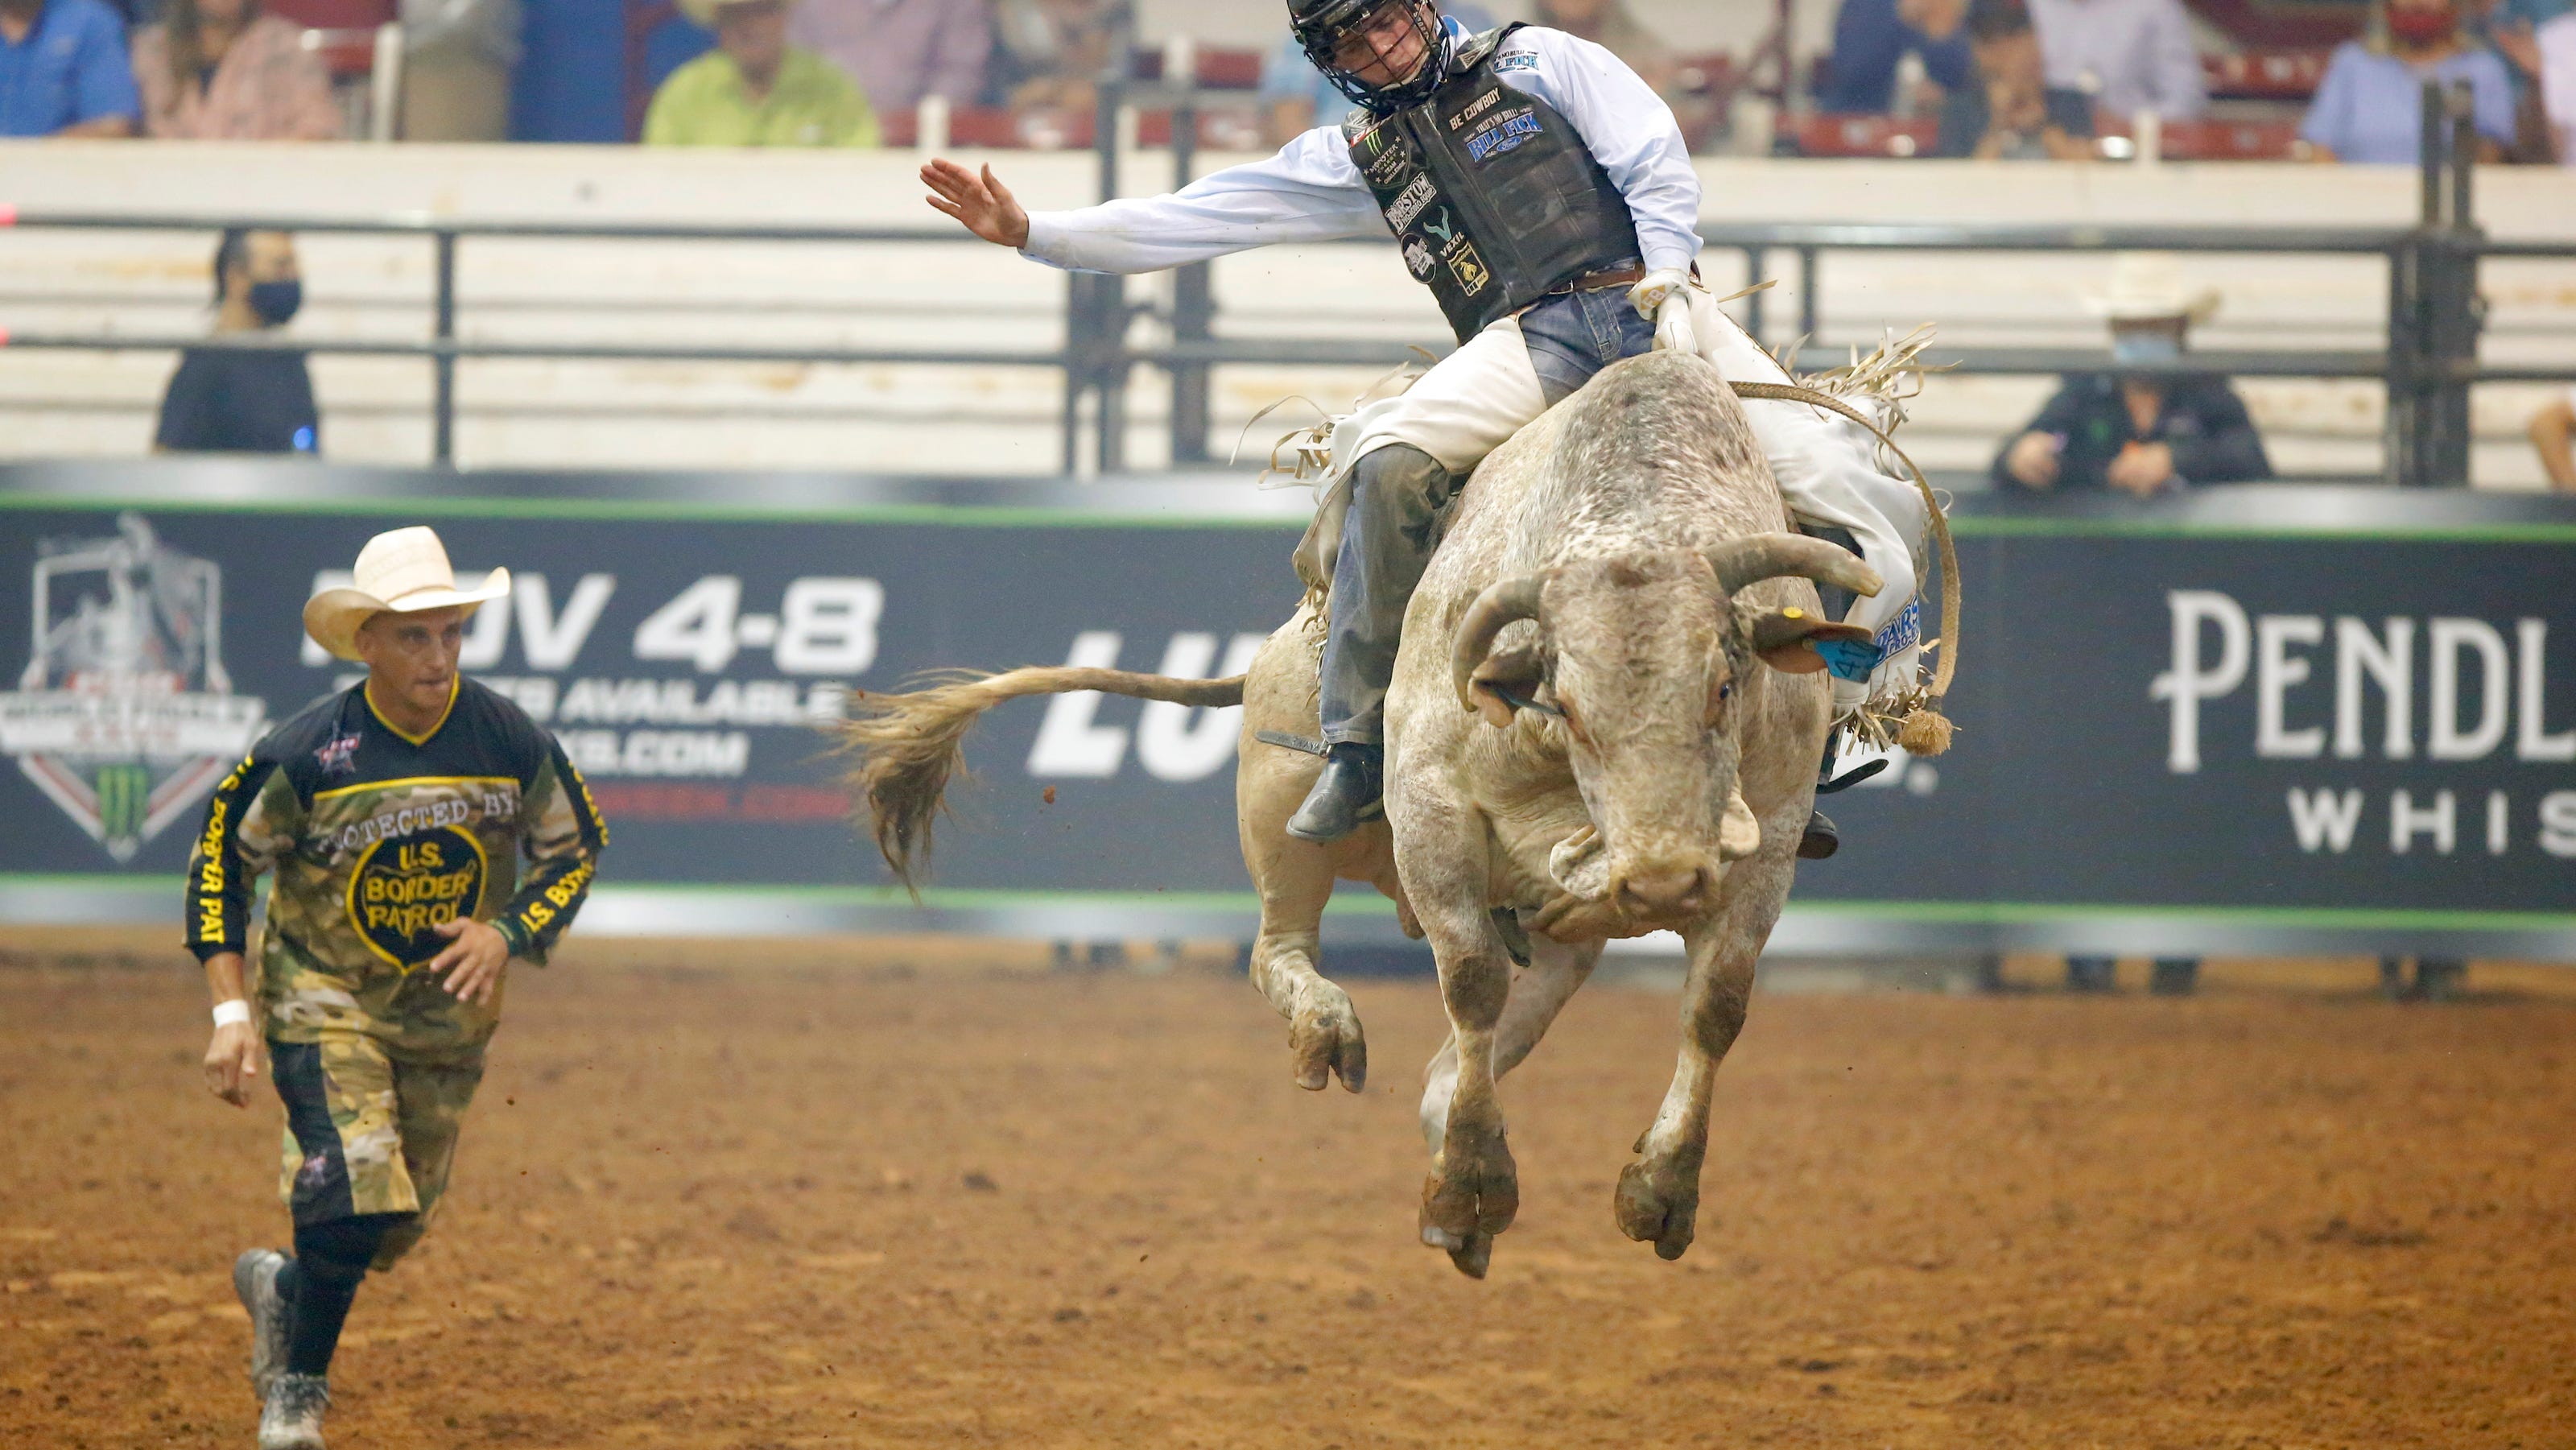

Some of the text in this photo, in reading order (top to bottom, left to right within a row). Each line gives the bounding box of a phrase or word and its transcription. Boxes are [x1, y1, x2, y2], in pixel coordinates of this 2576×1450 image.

[1505, 56, 1539, 70] FICK
[1449, 87, 1501, 130] BE COWBOY
[1493, 112, 1504, 125] NO
[1466, 111, 1543, 163] BILL FICK
[1368, 143, 1398, 173] MONSTER
[1439, 231, 1464, 257] VEXIL
[634, 573, 885, 675] 4-8
[398, 841, 445, 872] U.S.
[365, 870, 473, 902] BORDER
[199, 897, 226, 945] PAT
